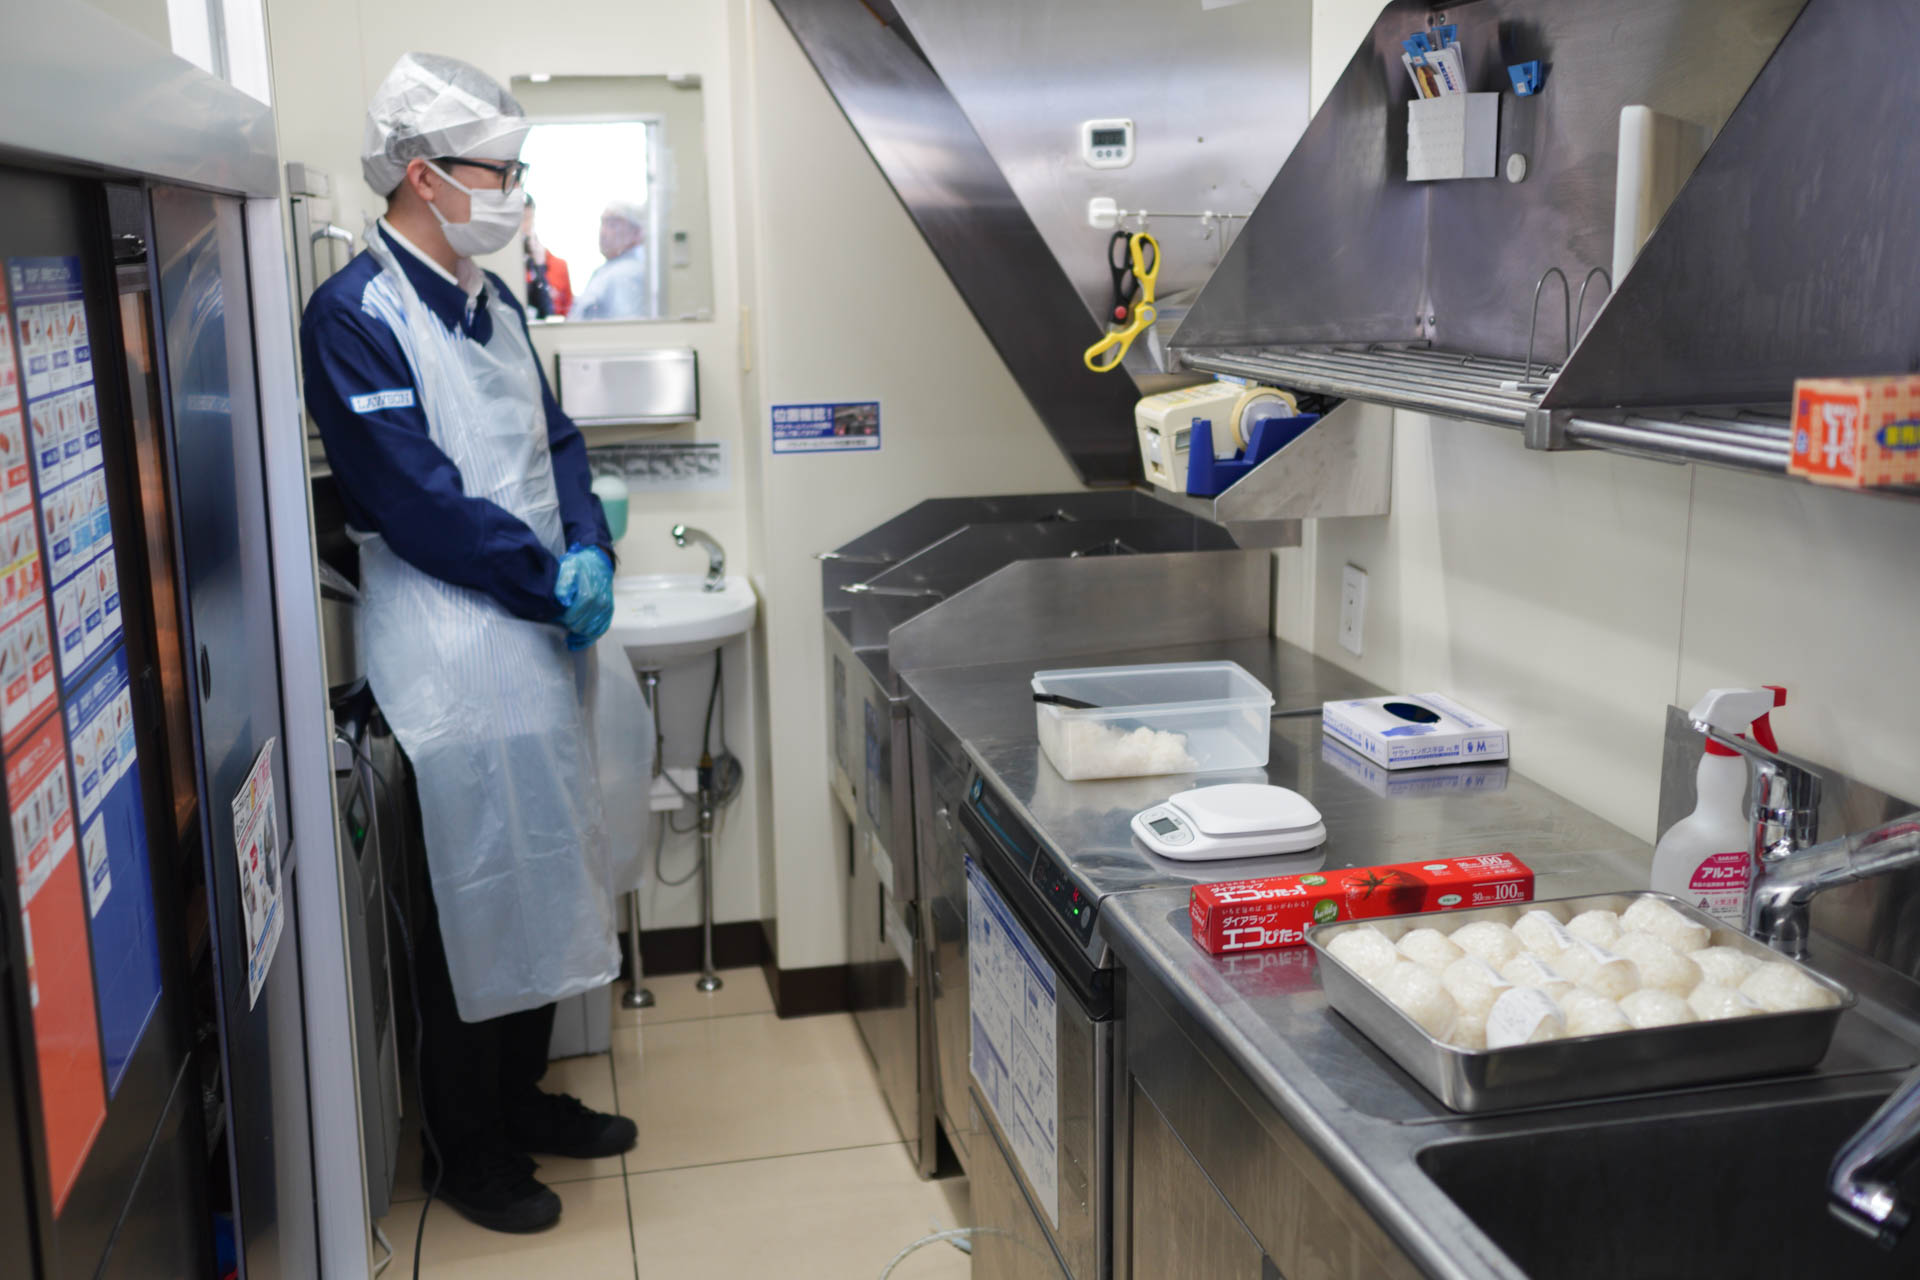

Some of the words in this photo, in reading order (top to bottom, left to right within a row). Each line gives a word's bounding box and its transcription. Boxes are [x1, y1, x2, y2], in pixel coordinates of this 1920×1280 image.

[1476, 740, 1488, 753] M
[1701, 865, 1746, 879] アルコー
[1222, 912, 1278, 928] ダイアラップ
